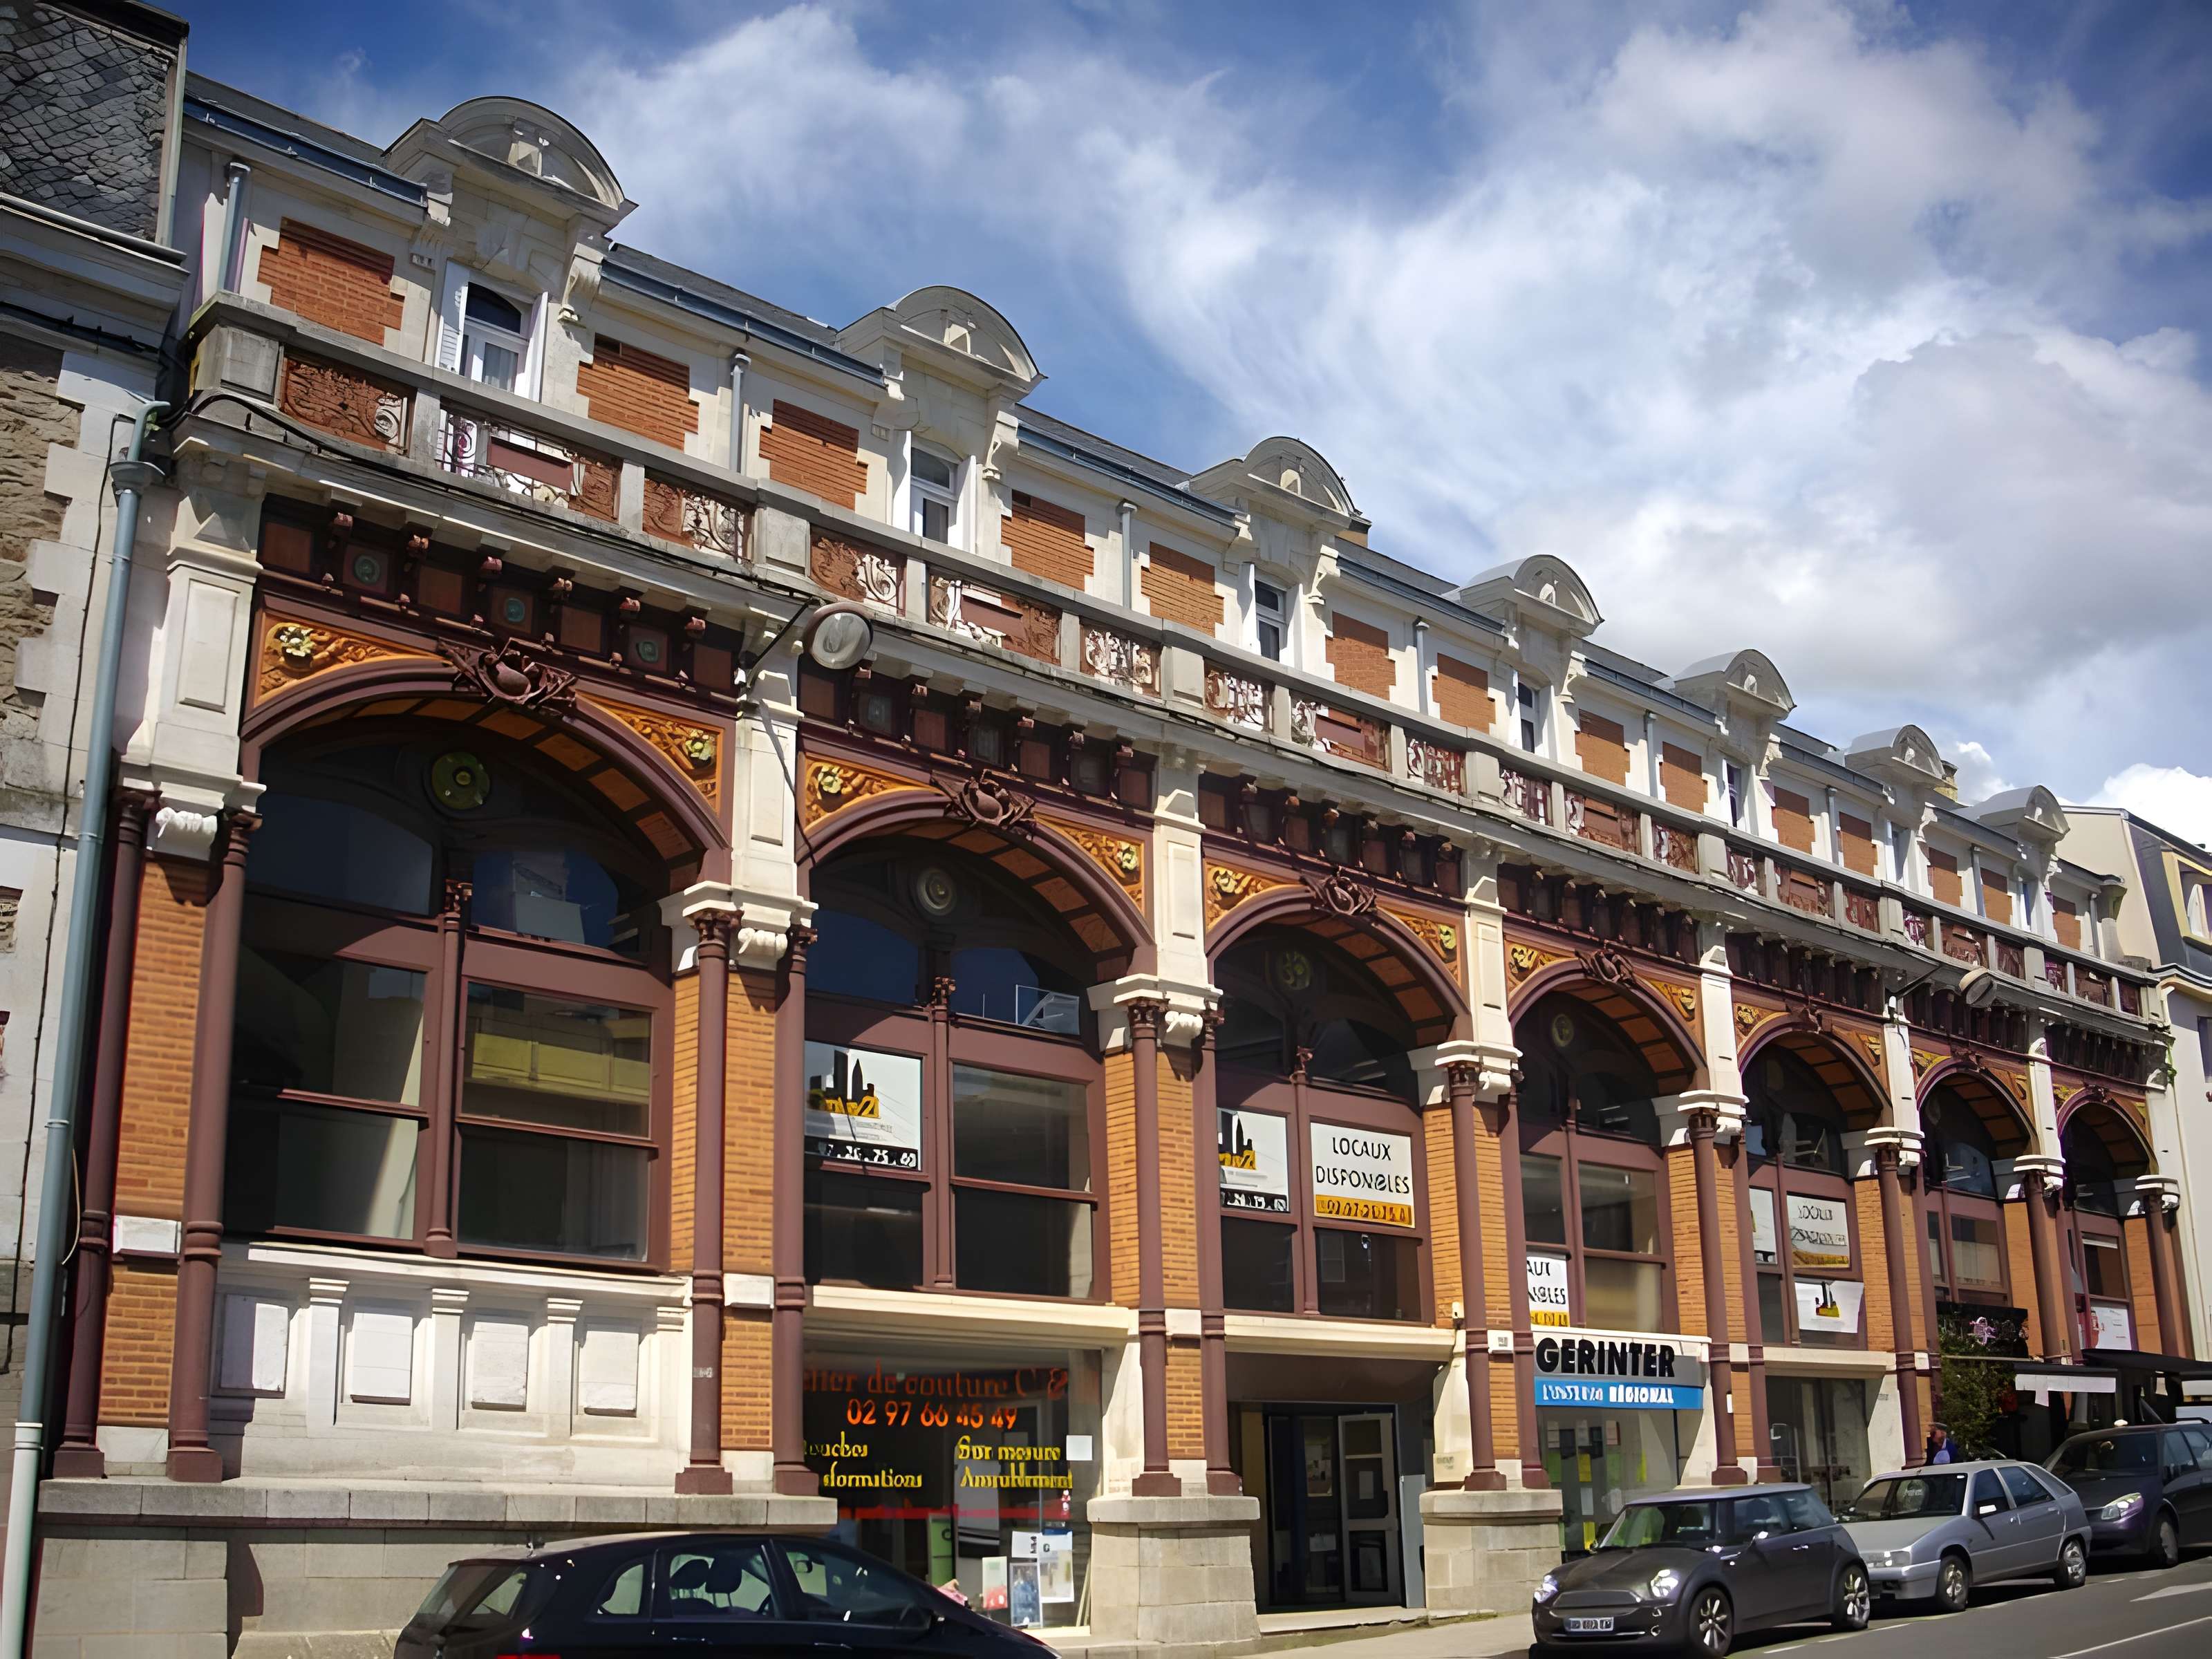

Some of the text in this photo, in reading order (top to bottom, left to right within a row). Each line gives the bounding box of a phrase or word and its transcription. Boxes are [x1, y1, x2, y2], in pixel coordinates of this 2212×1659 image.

[1333, 1137, 1391, 1161] LOCAUX
[1536, 1338, 1675, 1377] GERINTER
[847, 1398, 877, 1425] 02
[884, 1400, 912, 1426] 97
[921, 1400, 949, 1427] 66
